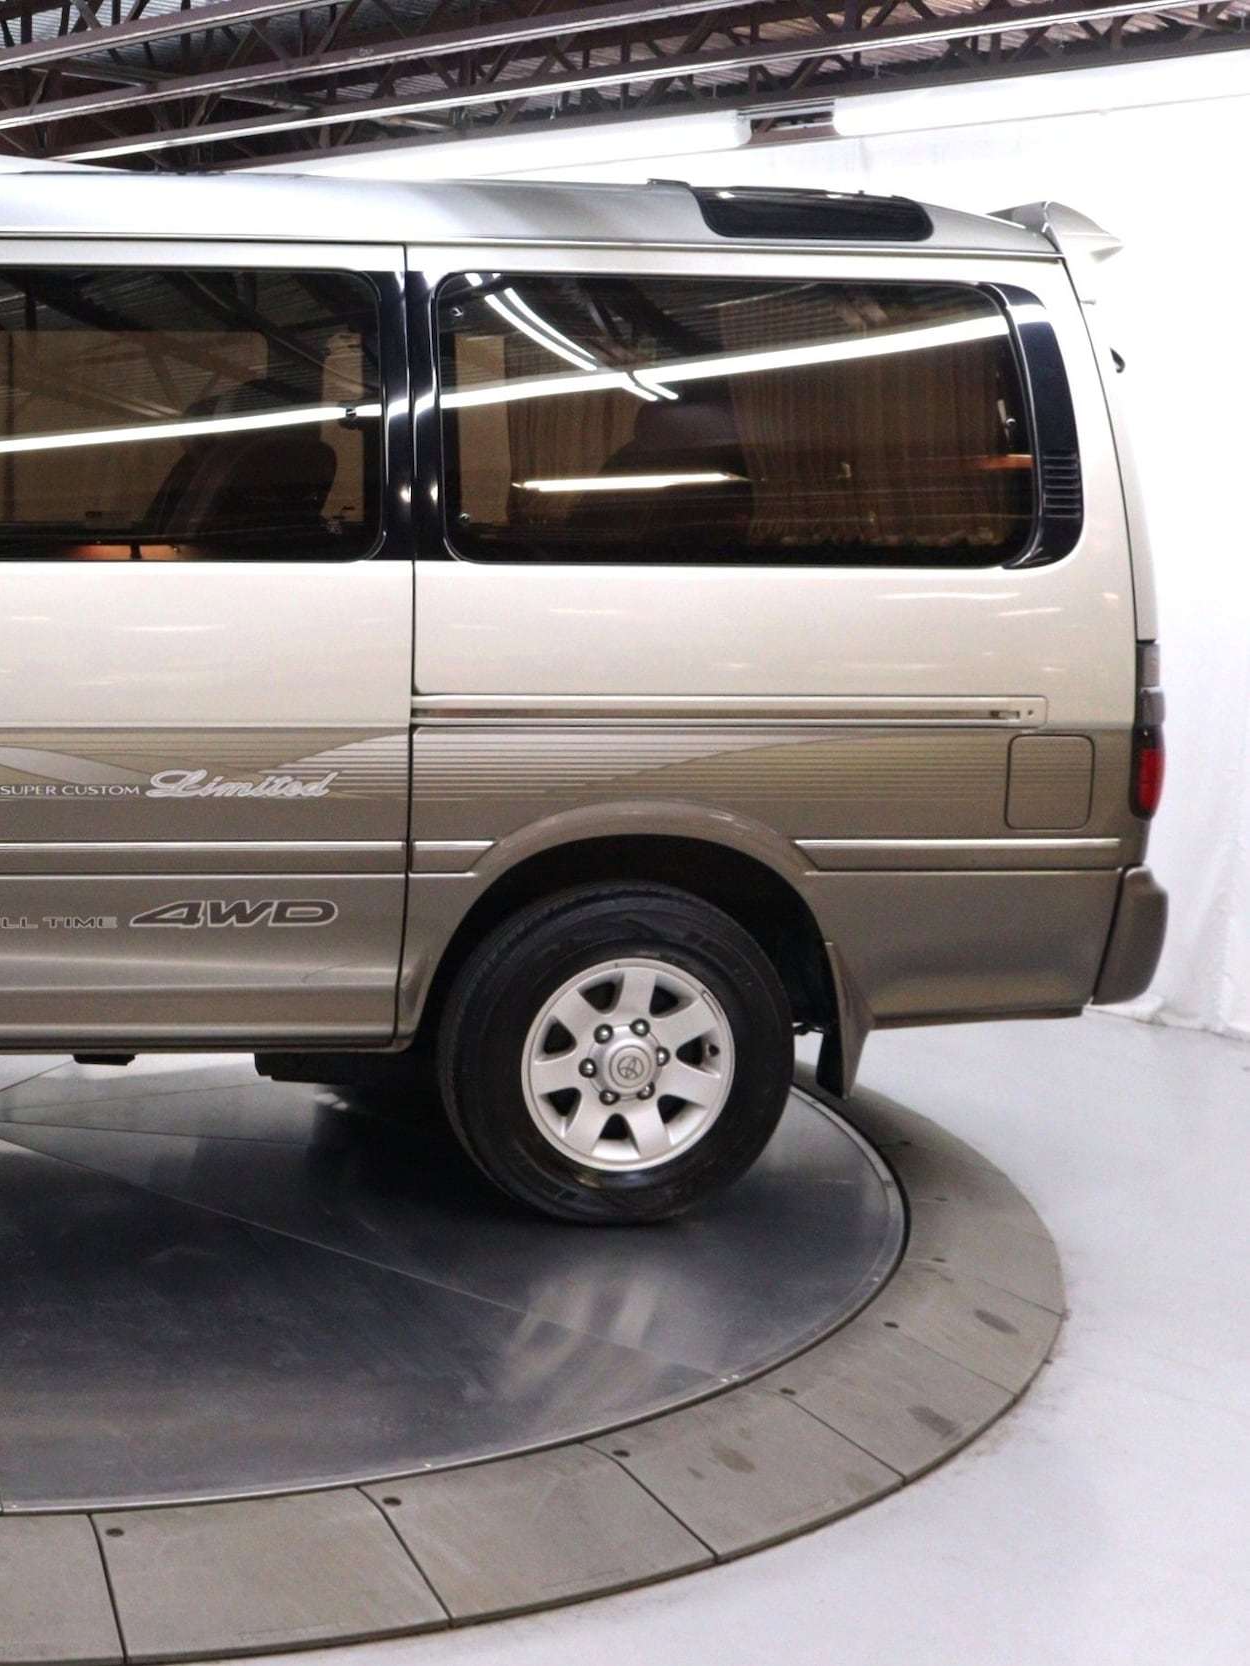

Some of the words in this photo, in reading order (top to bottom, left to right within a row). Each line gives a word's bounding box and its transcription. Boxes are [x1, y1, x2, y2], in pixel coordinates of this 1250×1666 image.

[61, 785, 140, 796] CUSTOM
[144, 769, 340, 799] Limited
[43, 916, 118, 929] TIME
[129, 900, 339, 929] 4WD
